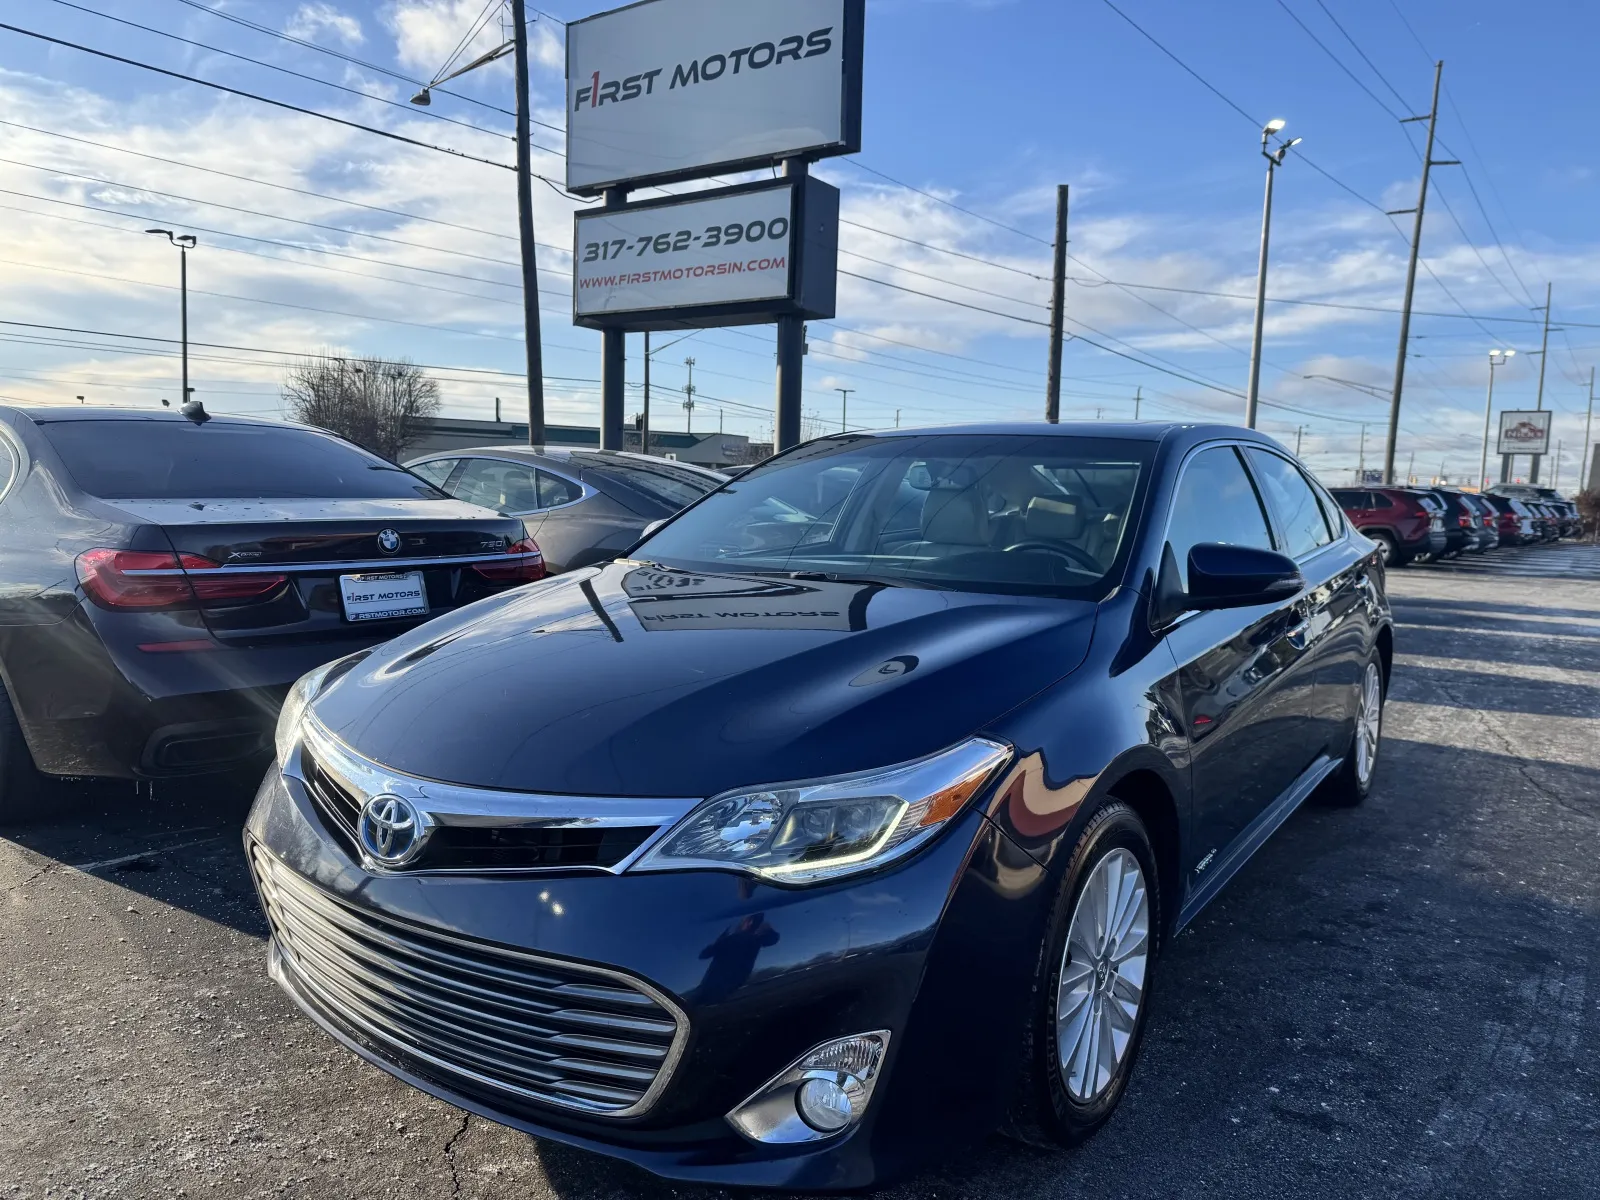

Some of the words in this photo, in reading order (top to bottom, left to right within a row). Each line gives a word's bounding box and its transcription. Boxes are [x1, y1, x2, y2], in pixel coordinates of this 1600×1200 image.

[669, 26, 834, 90] MOTORS
[582, 217, 789, 263] 317-762-3900
[579, 257, 785, 289] WWW.FIRSTMOTORSIN.COM
[378, 590, 421, 600] MOTORS
